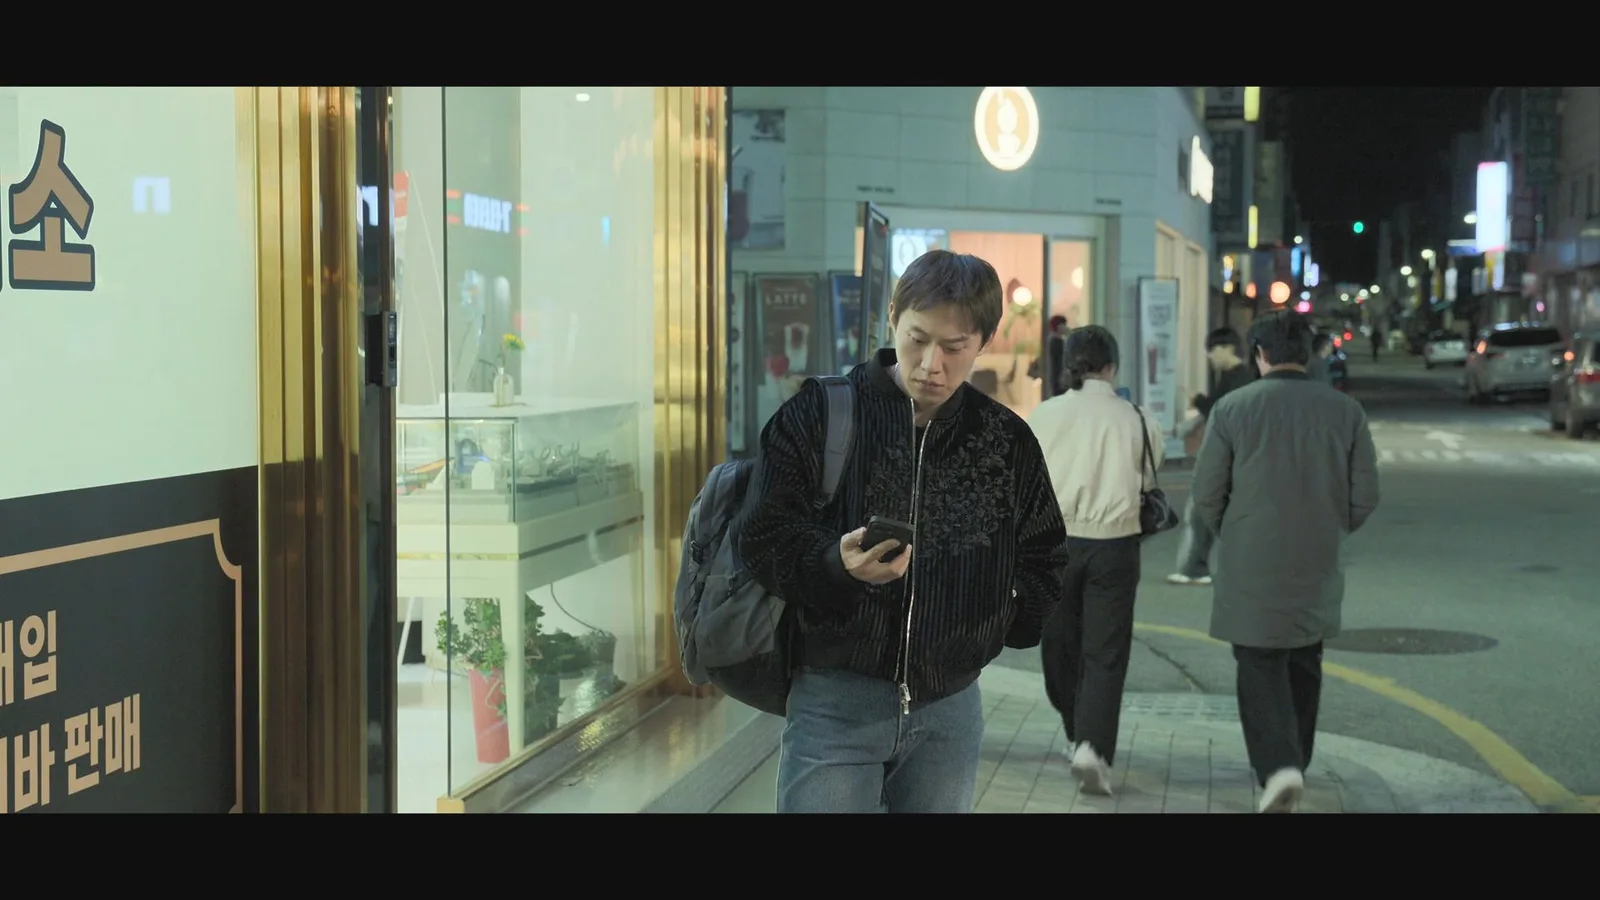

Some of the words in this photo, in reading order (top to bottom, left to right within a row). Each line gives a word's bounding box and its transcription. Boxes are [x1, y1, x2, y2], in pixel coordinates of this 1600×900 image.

[0, 118, 95, 291] 소
[764, 291, 807, 306] LATTE
[64, 693, 140, 795] 판매
